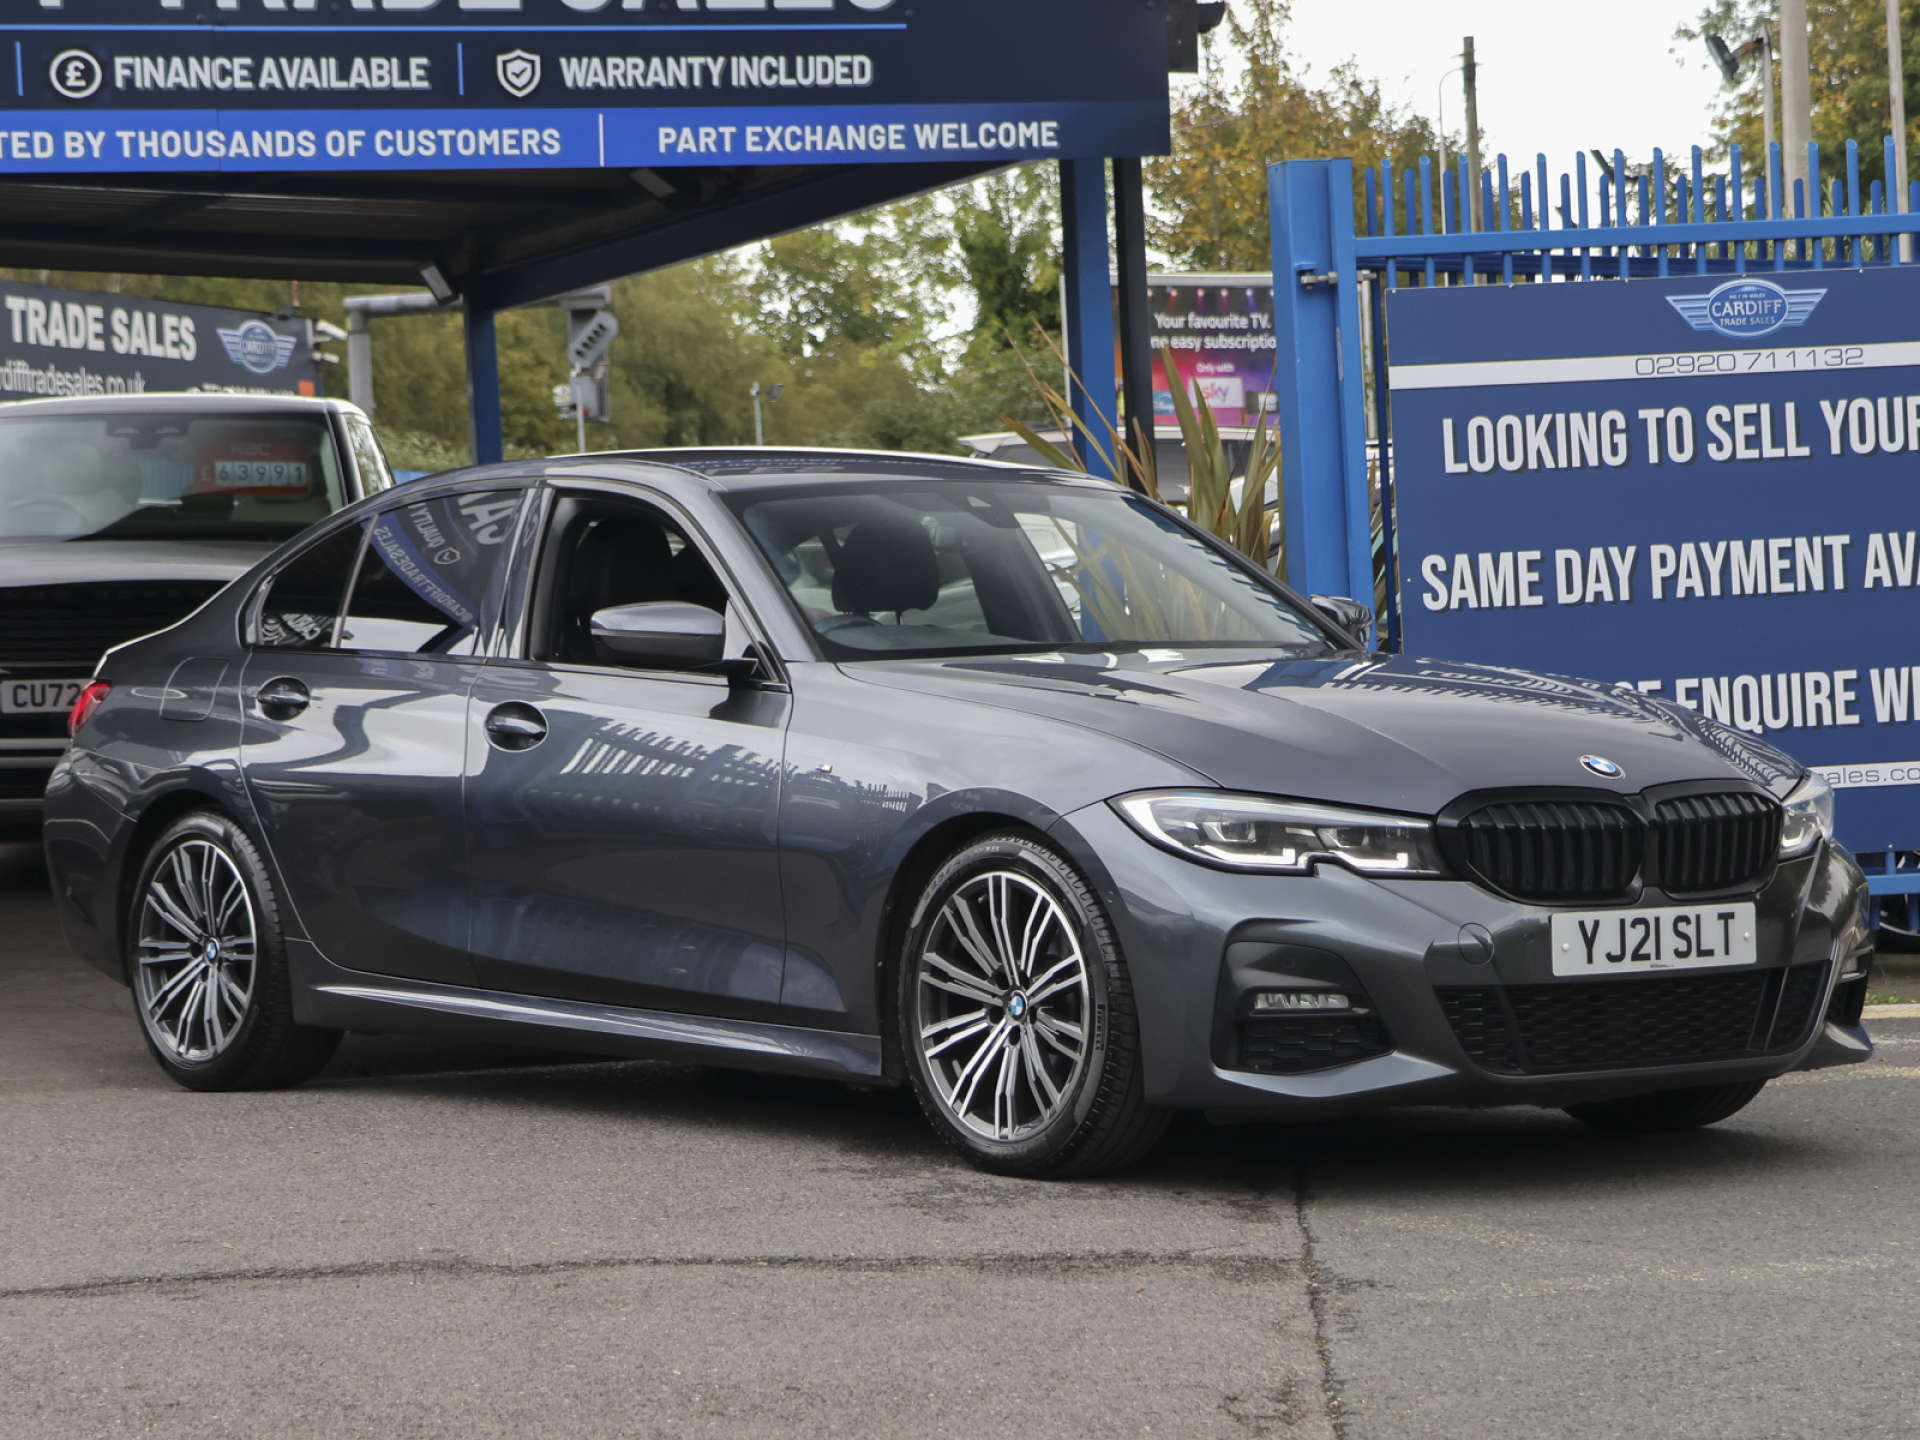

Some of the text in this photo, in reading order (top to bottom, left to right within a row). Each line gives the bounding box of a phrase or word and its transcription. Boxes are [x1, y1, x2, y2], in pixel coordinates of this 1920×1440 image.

[114, 56, 252, 89] FINANCE
[259, 56, 430, 89] AVAILABLE
[560, 54, 873, 87] WARRANTY INCLUDED
[64, 130, 105, 159] BY
[116, 129, 316, 159] THOUSANDS
[325, 129, 366, 158] OF
[374, 127, 562, 157] CUSTOMERS
[657, 121, 1060, 154] PART EXCHANGE WELCOME
[1153, 312, 1273, 329] Your favourite TV.
[1711, 299, 1782, 317] CARDIFF
[1720, 316, 1776, 327] TRADE SALES
[5, 294, 105, 352] TRADE
[110, 306, 198, 362] SALES
[1170, 336, 1202, 352] easy
[1635, 347, 1864, 376] 02920 711132
[1201, 382, 1229, 402] sky
[1442, 409, 1628, 474] LOOKING
[1638, 406, 1694, 464] TO
[1706, 401, 1810, 462] SELL
[1421, 531, 1920, 612] SAME DAY PAYMENT AV
[13, 683, 81, 708] CU72
[1675, 670, 1860, 734] ENQUIRE
[1824, 764, 1920, 785] ales.co
[1578, 912, 1735, 965] YJ21 SLT
